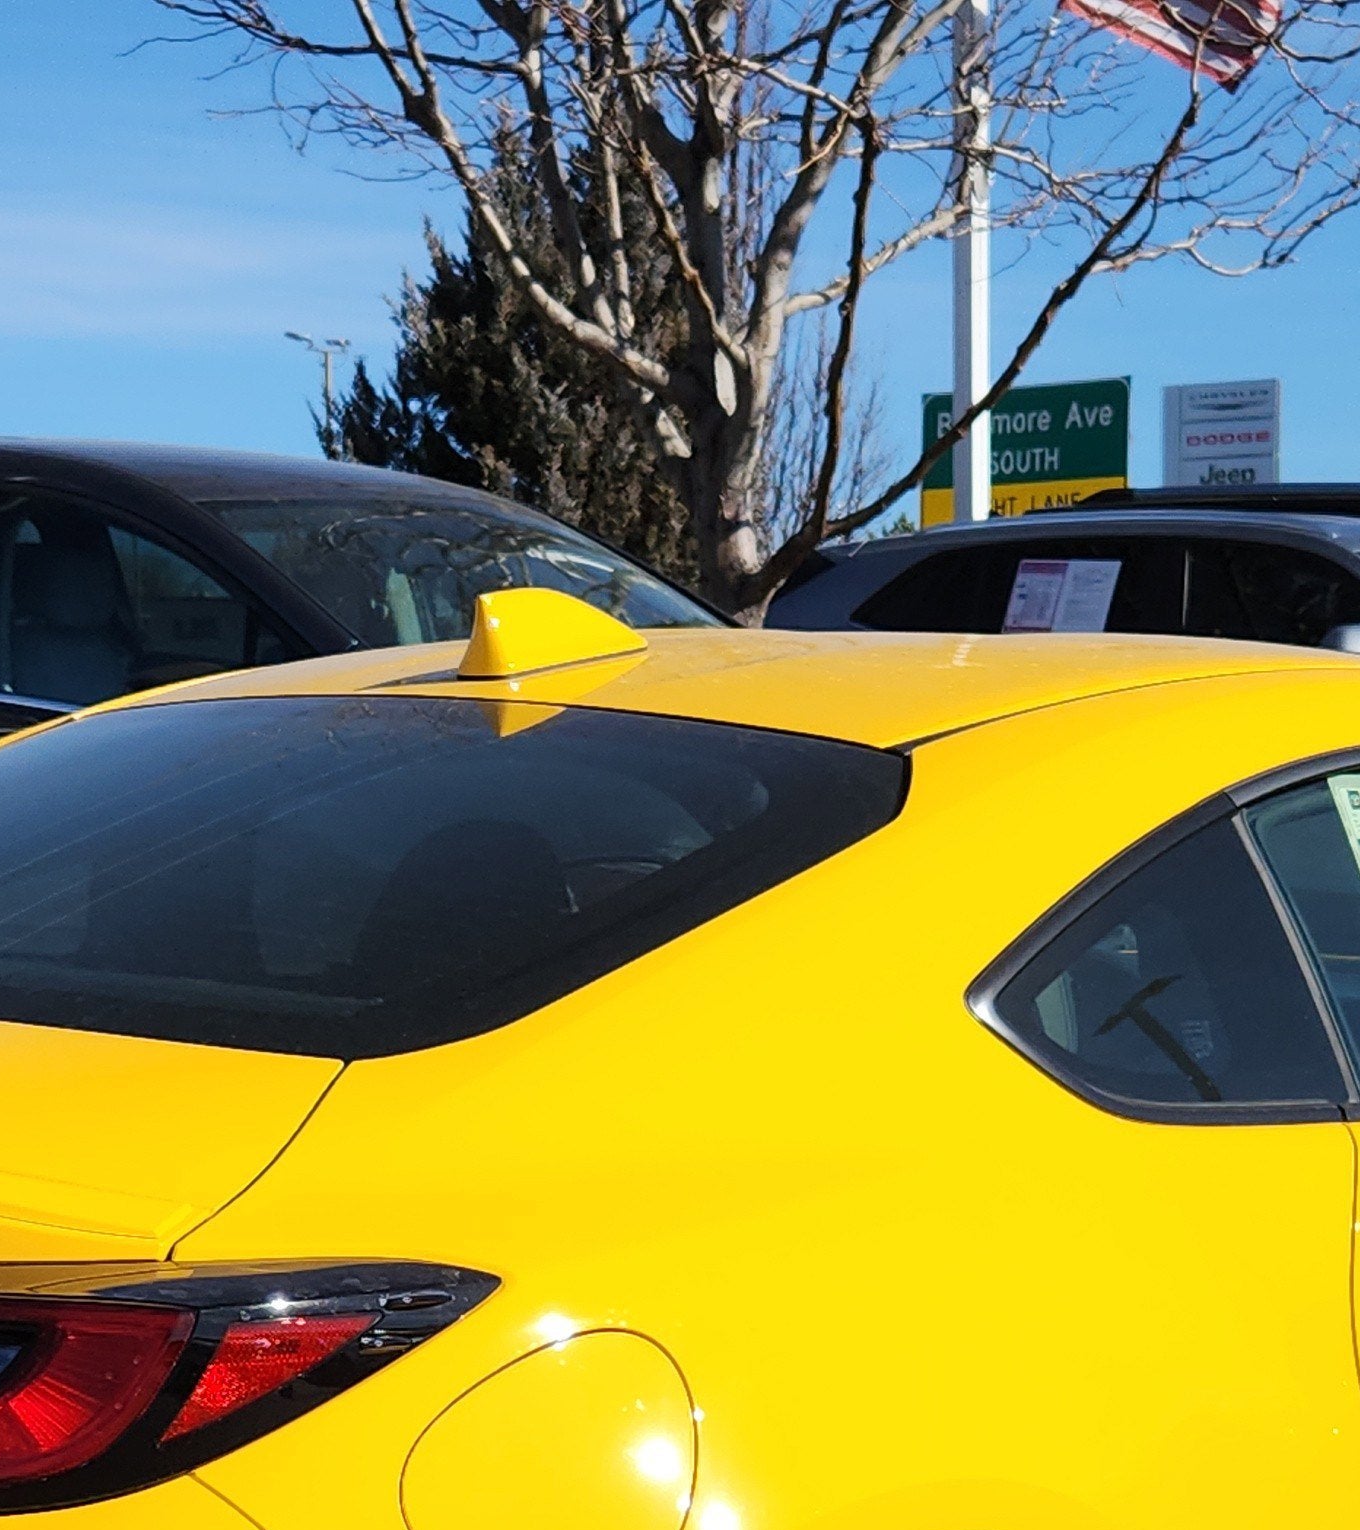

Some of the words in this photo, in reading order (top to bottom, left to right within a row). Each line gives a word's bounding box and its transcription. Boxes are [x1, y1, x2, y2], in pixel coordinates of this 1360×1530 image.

[1065, 401, 1114, 430] Ave
[1186, 430, 1270, 448] DODGE
[990, 447, 1061, 475] SOUTH
[1199, 463, 1257, 485] Jeep
